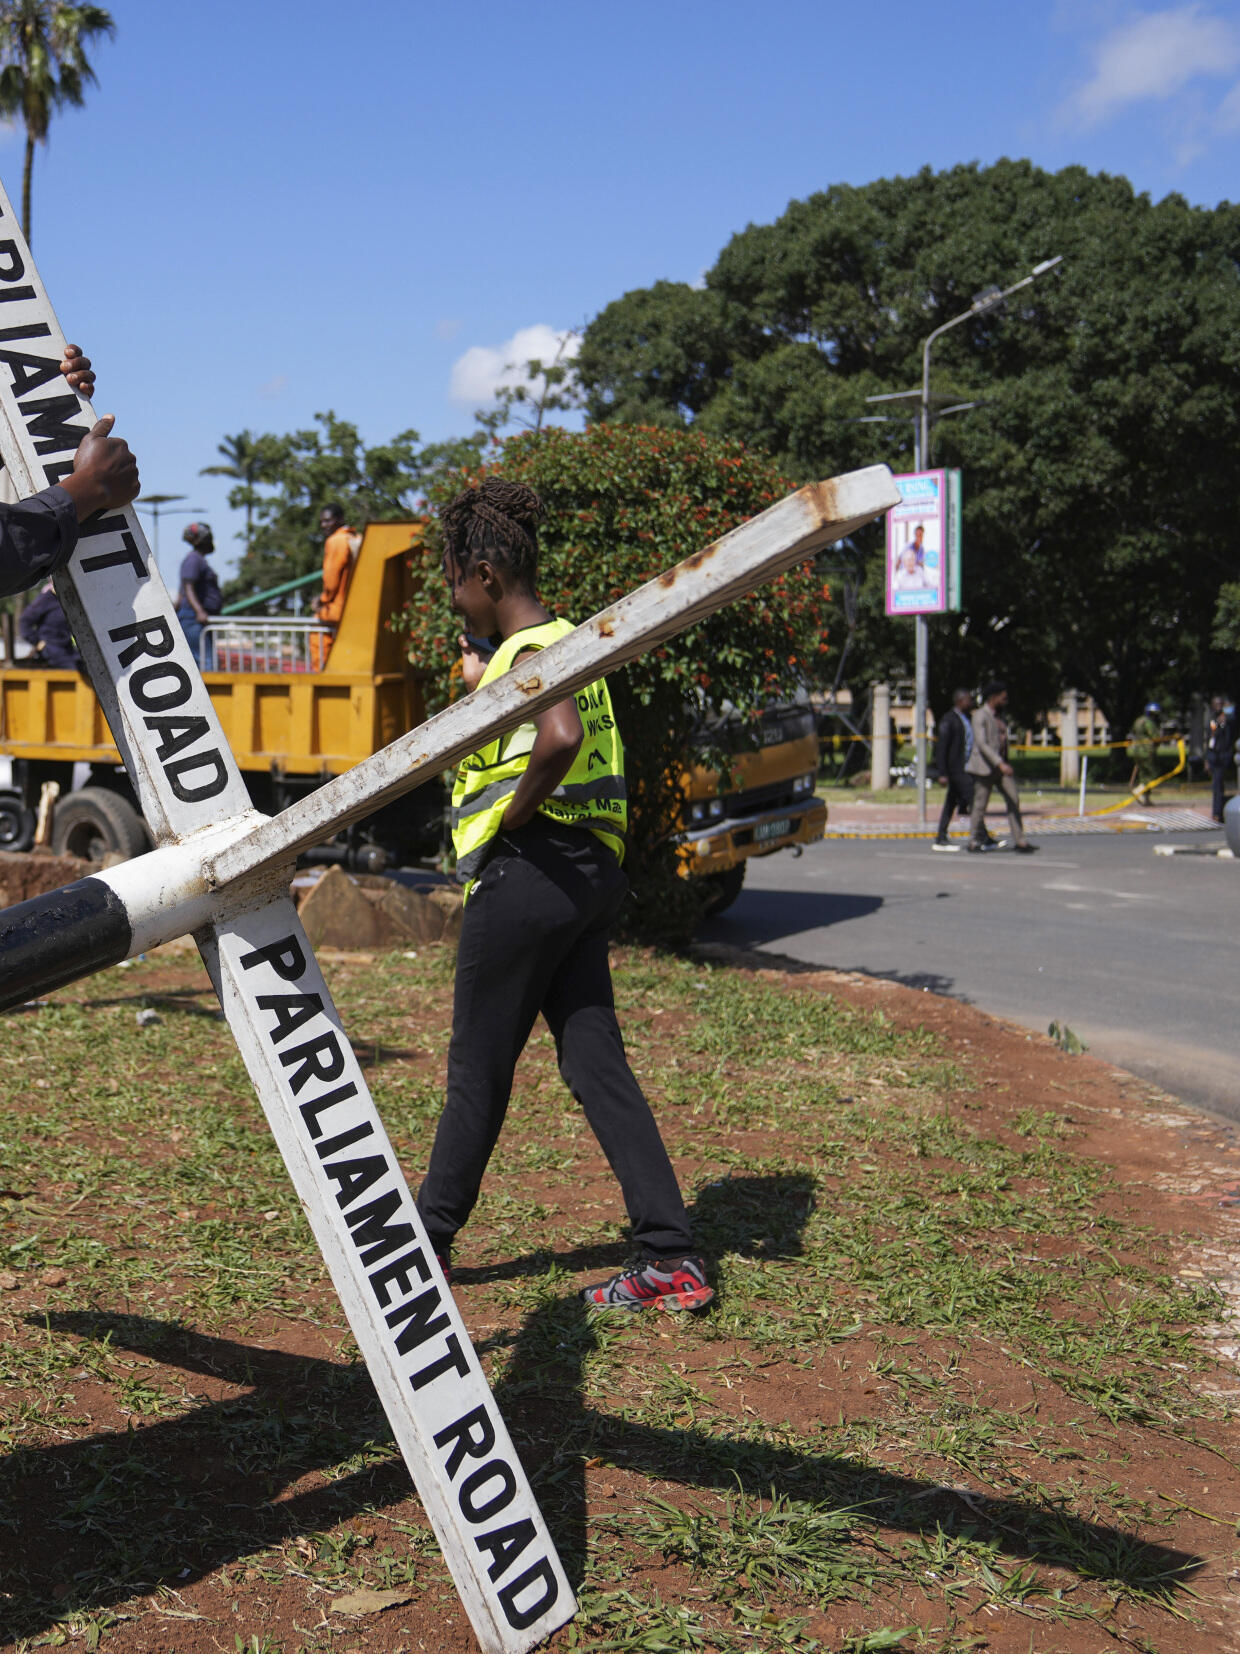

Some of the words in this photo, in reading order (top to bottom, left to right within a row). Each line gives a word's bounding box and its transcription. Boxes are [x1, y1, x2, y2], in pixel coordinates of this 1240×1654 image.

[108, 615, 229, 804] ROAD
[240, 934, 471, 1392] PARLIAMENT
[433, 1403, 559, 1631] ROAD
